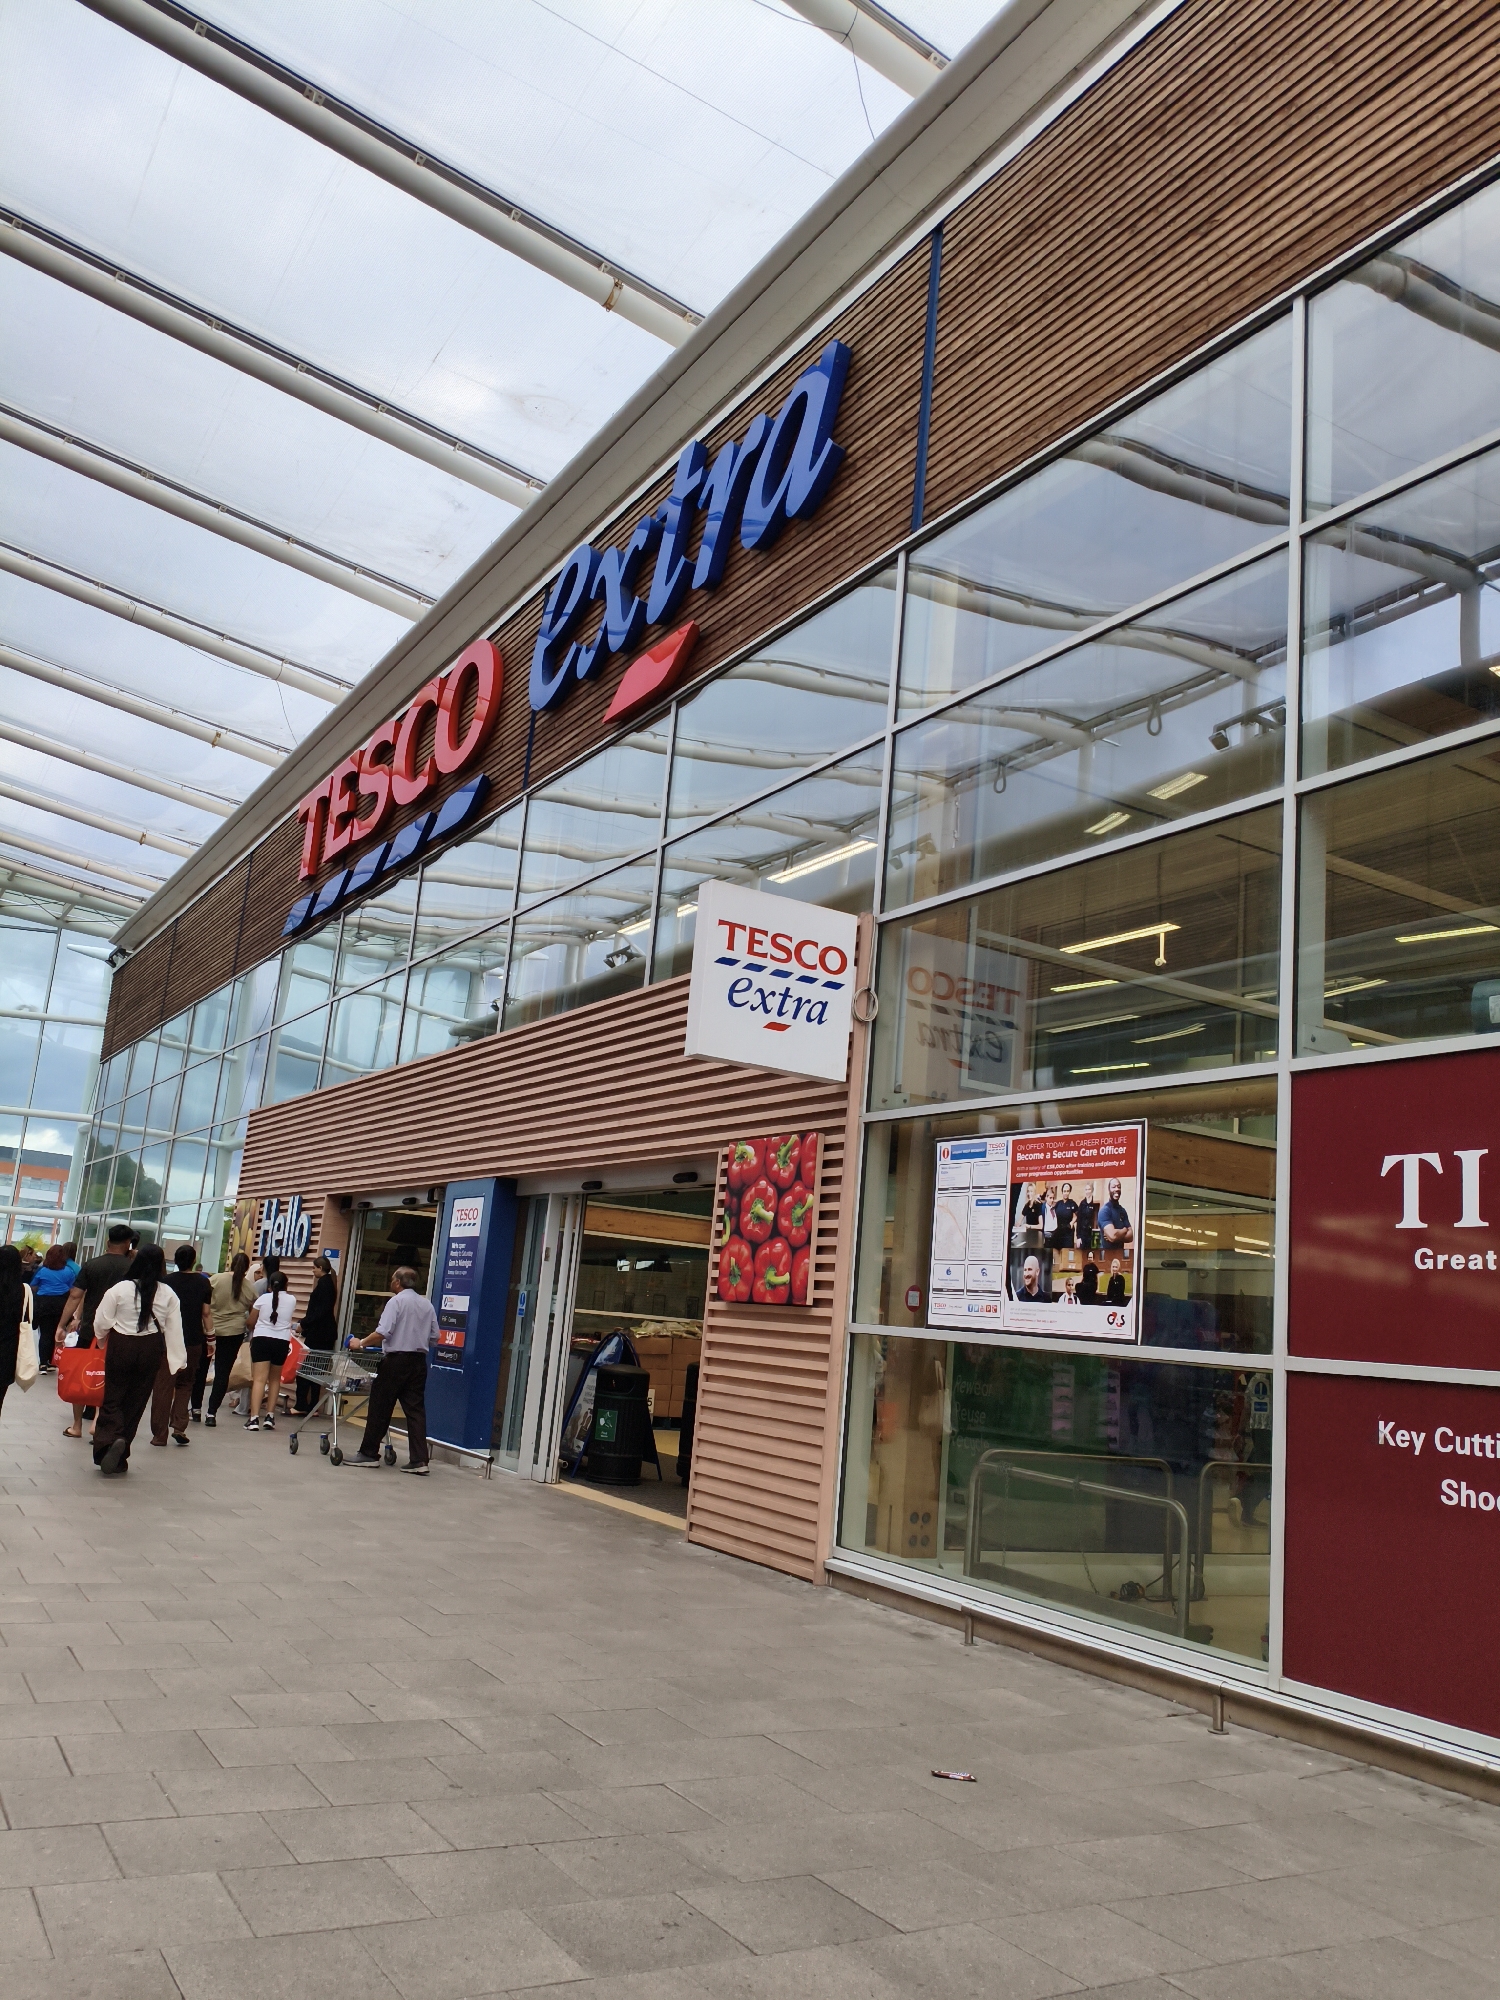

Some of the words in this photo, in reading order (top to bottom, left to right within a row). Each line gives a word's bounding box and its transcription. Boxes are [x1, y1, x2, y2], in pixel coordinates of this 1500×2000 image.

[297, 639, 504, 881] TESCO
[528, 338, 853, 711] extra
[717, 919, 848, 976] TESCO
[728, 977, 828, 1025] extra
[1016, 1152, 1044, 1161] Become
[1052, 1149, 1078, 1159] Secure
[1080, 1147, 1098, 1157] Care
[1099, 1145, 1127, 1155] Officer
[1026, 1142, 1044, 1150] OFFER
[1046, 1141, 1065, 1149] TODAY
[1075, 1138, 1100, 1147] CAREER
[1101, 1137, 1114, 1145] FOR
[1114, 1136, 1127, 1144] LIFE
[1381, 1149, 1489, 1229] TI
[258, 1195, 311, 1258] Hello
[456, 1208, 479, 1221] TESCO
[1414, 1247, 1497, 1271] Great
[955, 1402, 986, 1424] Reuse
[1378, 1420, 1427, 1456] Key
[1440, 1478, 1500, 1512] Sho
